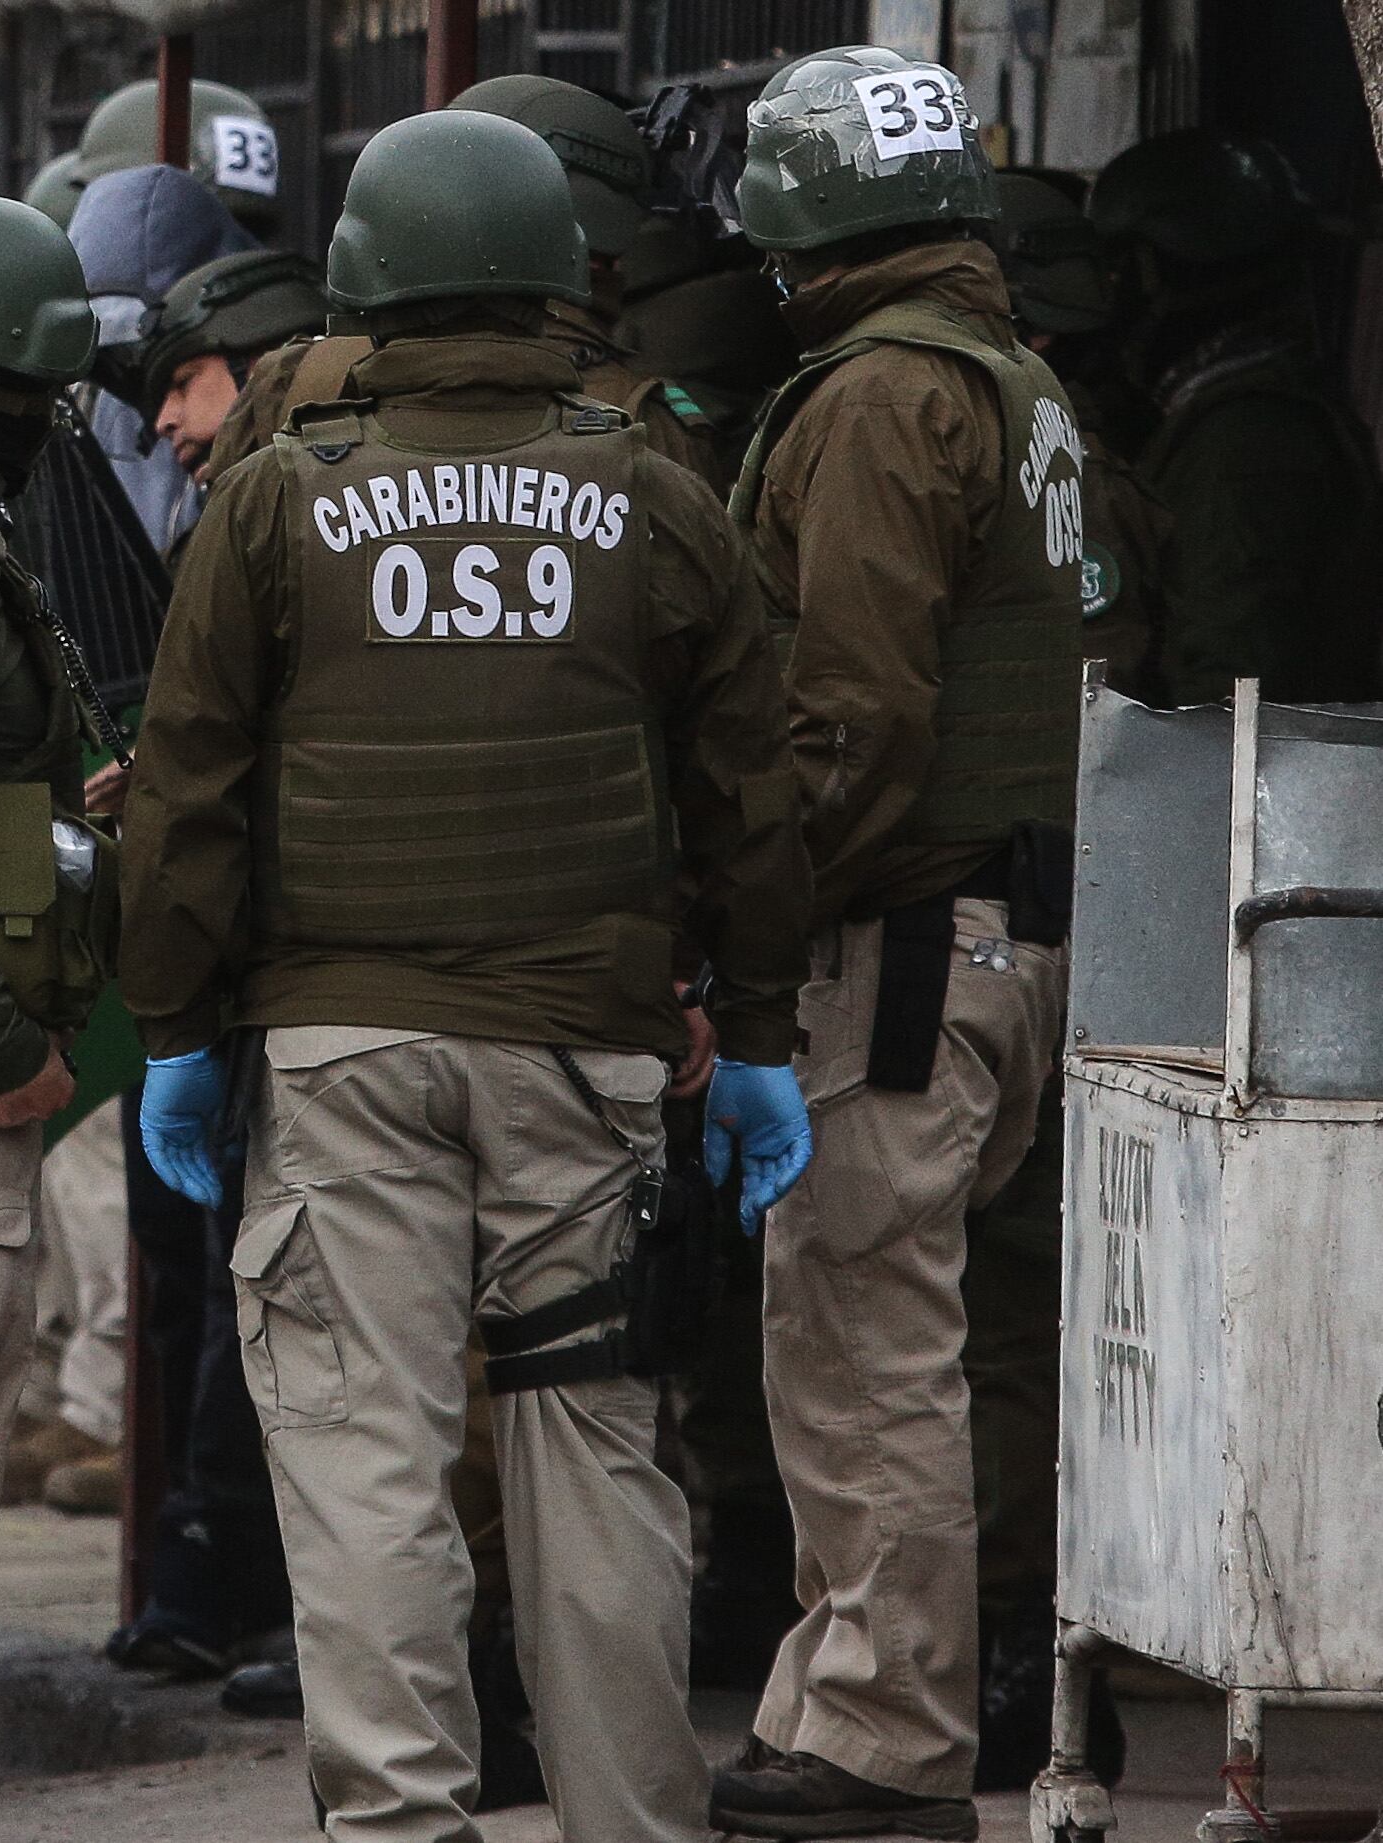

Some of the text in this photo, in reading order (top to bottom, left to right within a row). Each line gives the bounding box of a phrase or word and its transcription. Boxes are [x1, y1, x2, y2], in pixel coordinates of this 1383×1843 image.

[870, 79, 953, 137] 33
[226, 129, 276, 175] 33
[312, 463, 630, 553] CARABINEROS
[372, 543, 573, 638] O.S.9
